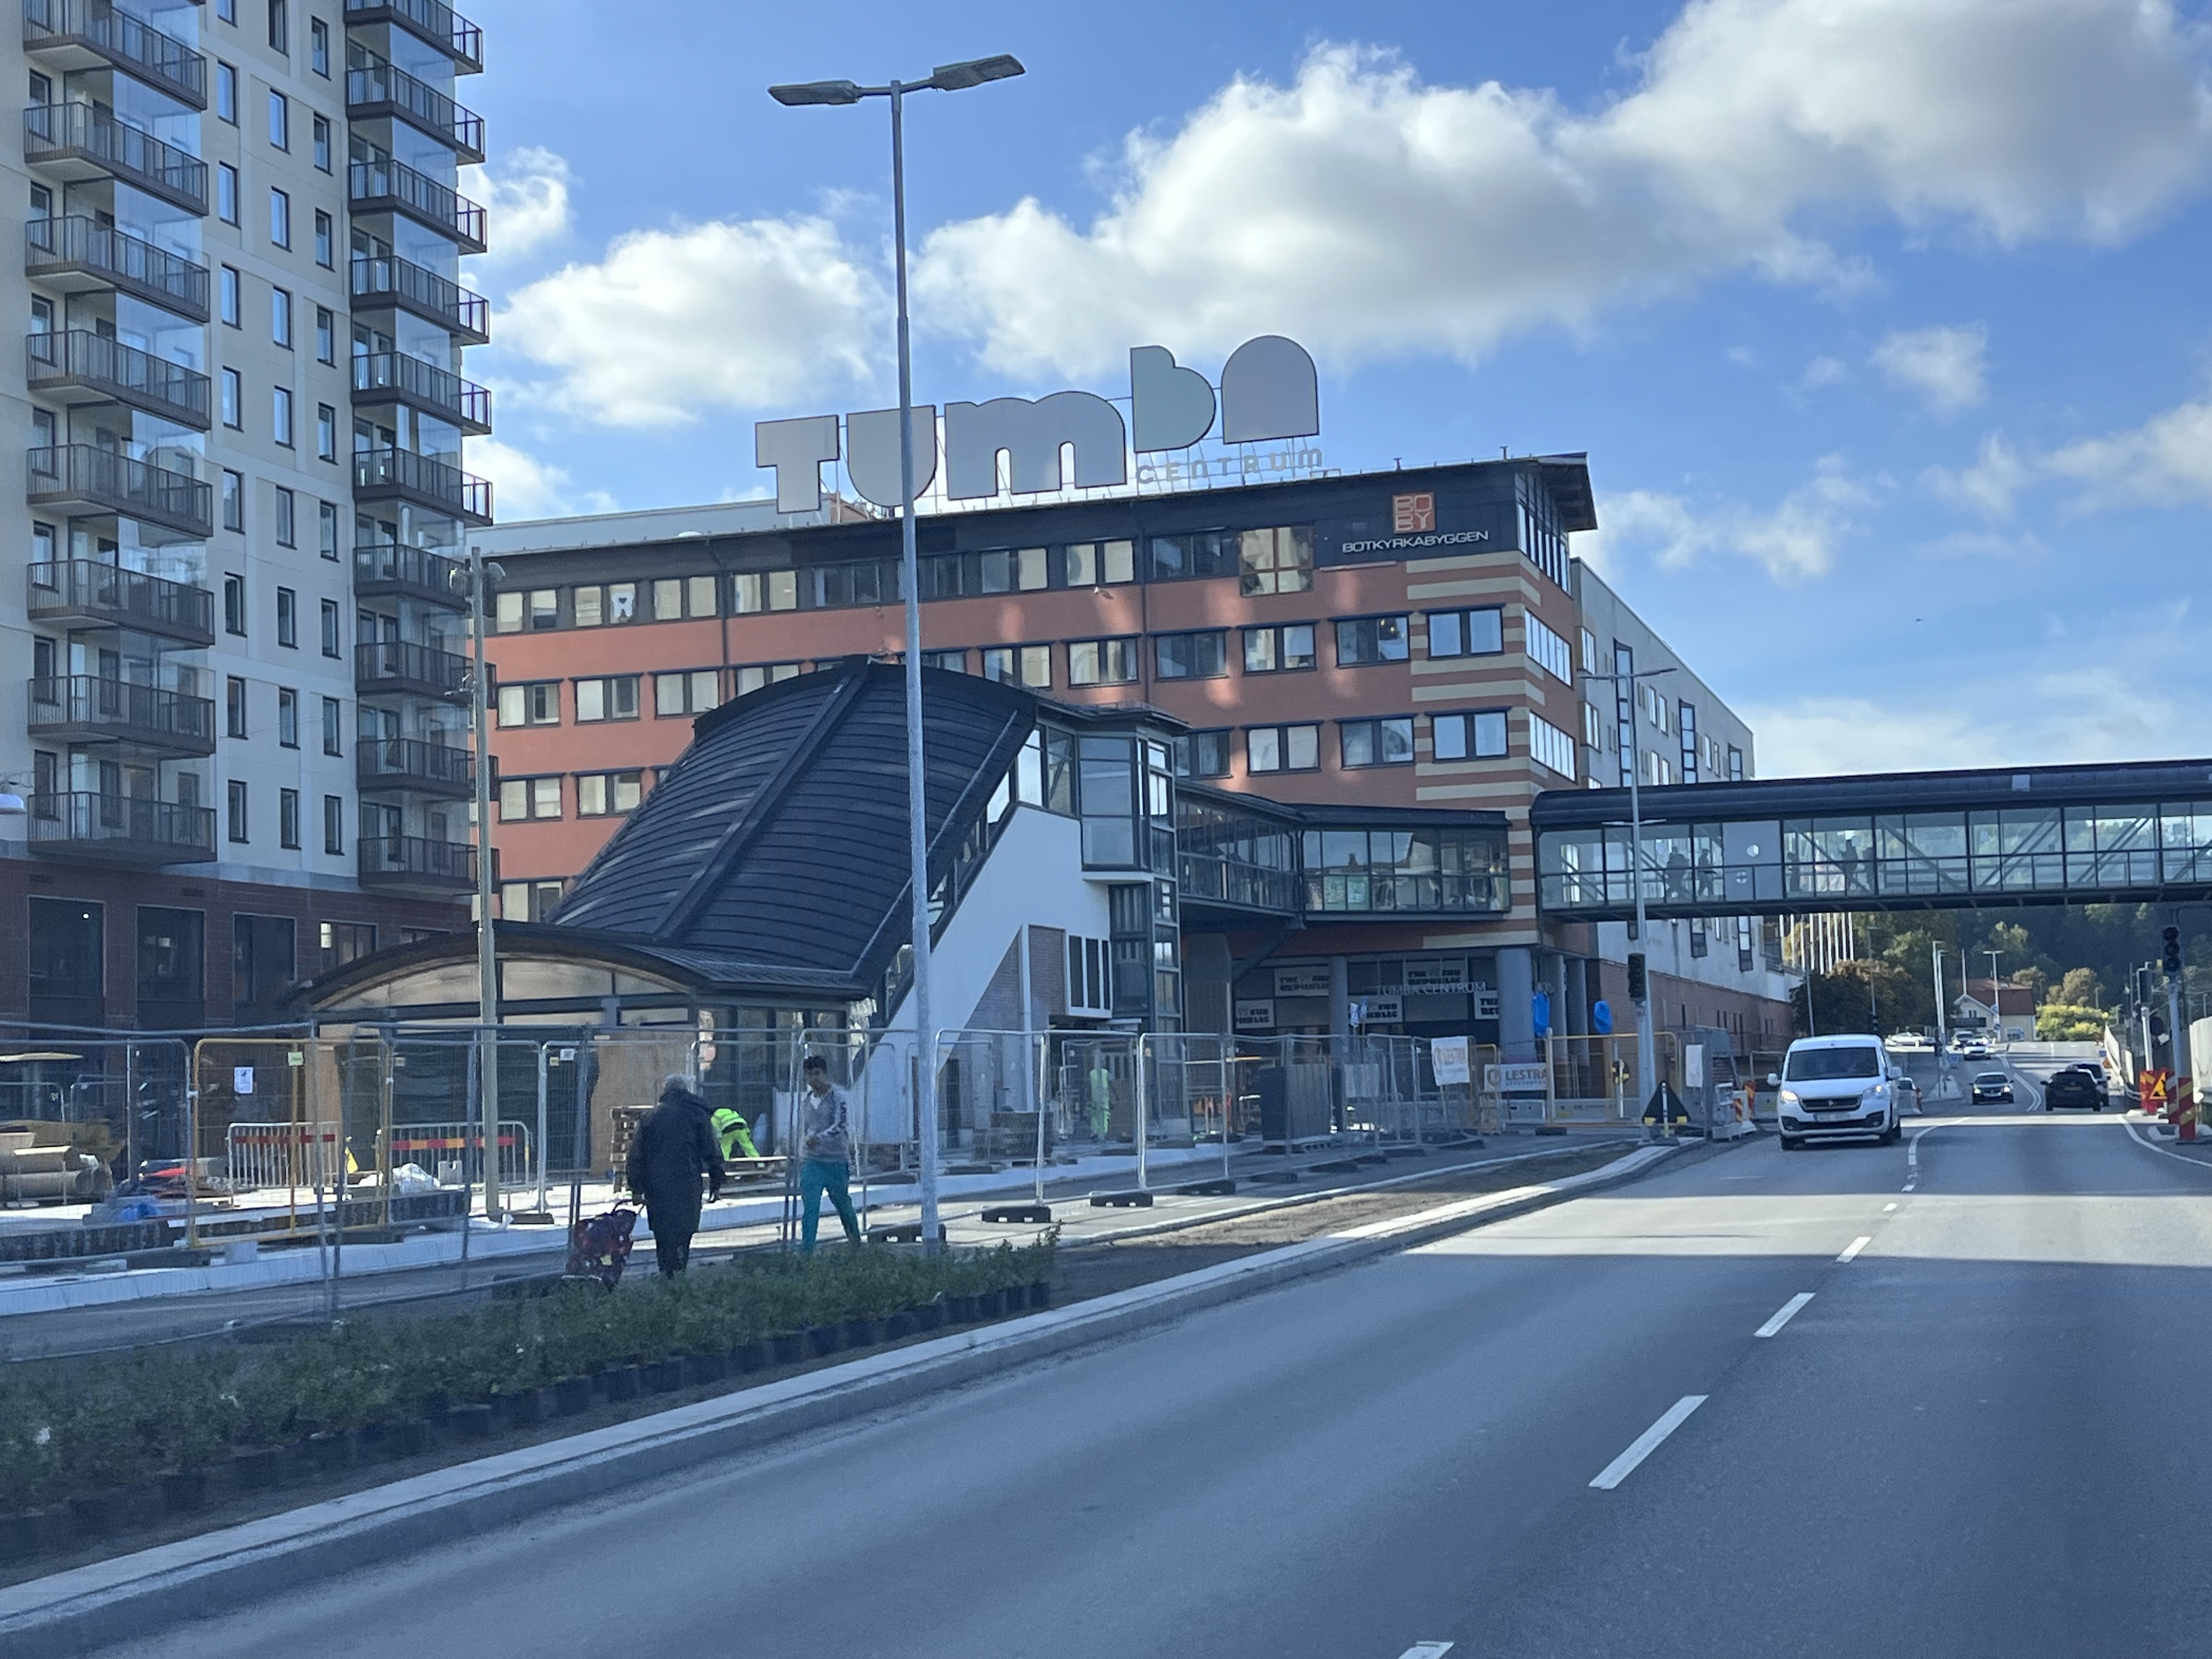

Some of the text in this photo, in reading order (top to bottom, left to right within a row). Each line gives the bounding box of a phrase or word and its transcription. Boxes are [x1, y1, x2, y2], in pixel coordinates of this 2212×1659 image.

[1342, 531, 1489, 553] BOTKYRKABYGGEN
[1376, 981, 1487, 996] TUMBA CENTRUM
